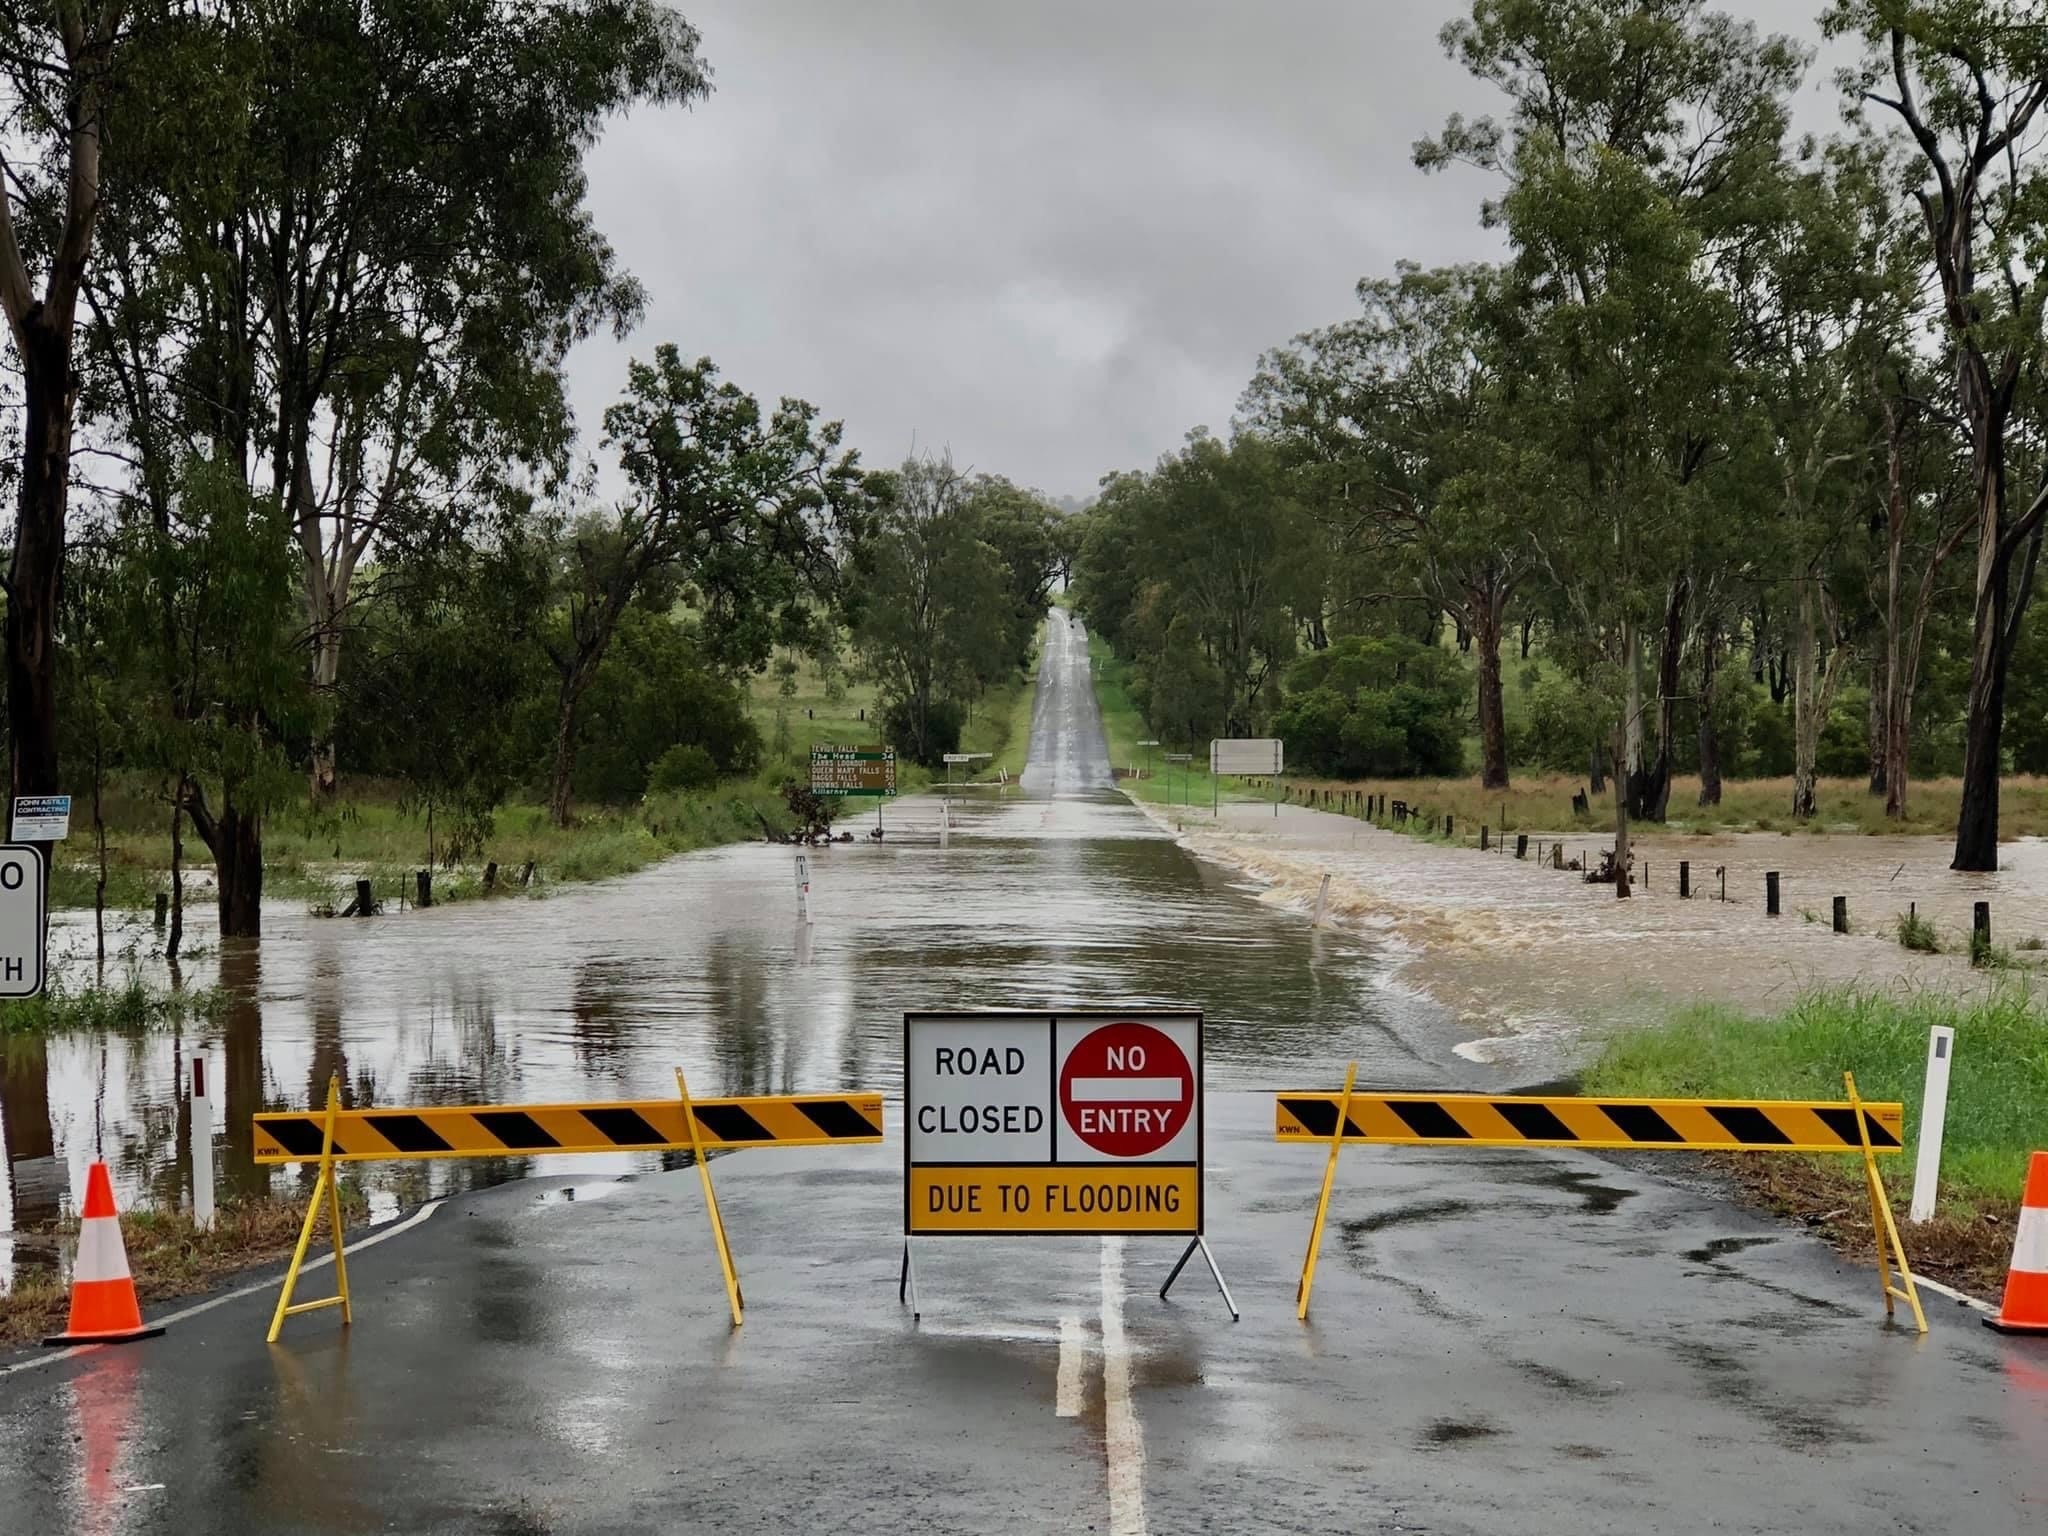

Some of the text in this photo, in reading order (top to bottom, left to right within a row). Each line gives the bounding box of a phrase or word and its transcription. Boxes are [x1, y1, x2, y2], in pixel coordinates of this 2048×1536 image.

[838, 744, 858, 752] FALLS
[881, 752, 894, 760] 34
[812, 788, 848, 796] Killarney
[935, 1047, 1025, 1075] ROAD
[1106, 1046, 1146, 1071] NO
[918, 1105, 1044, 1133] CLOSED
[1080, 1109, 1173, 1133] ENTRY
[928, 1184, 1180, 1213] DUE TO FLOODING
